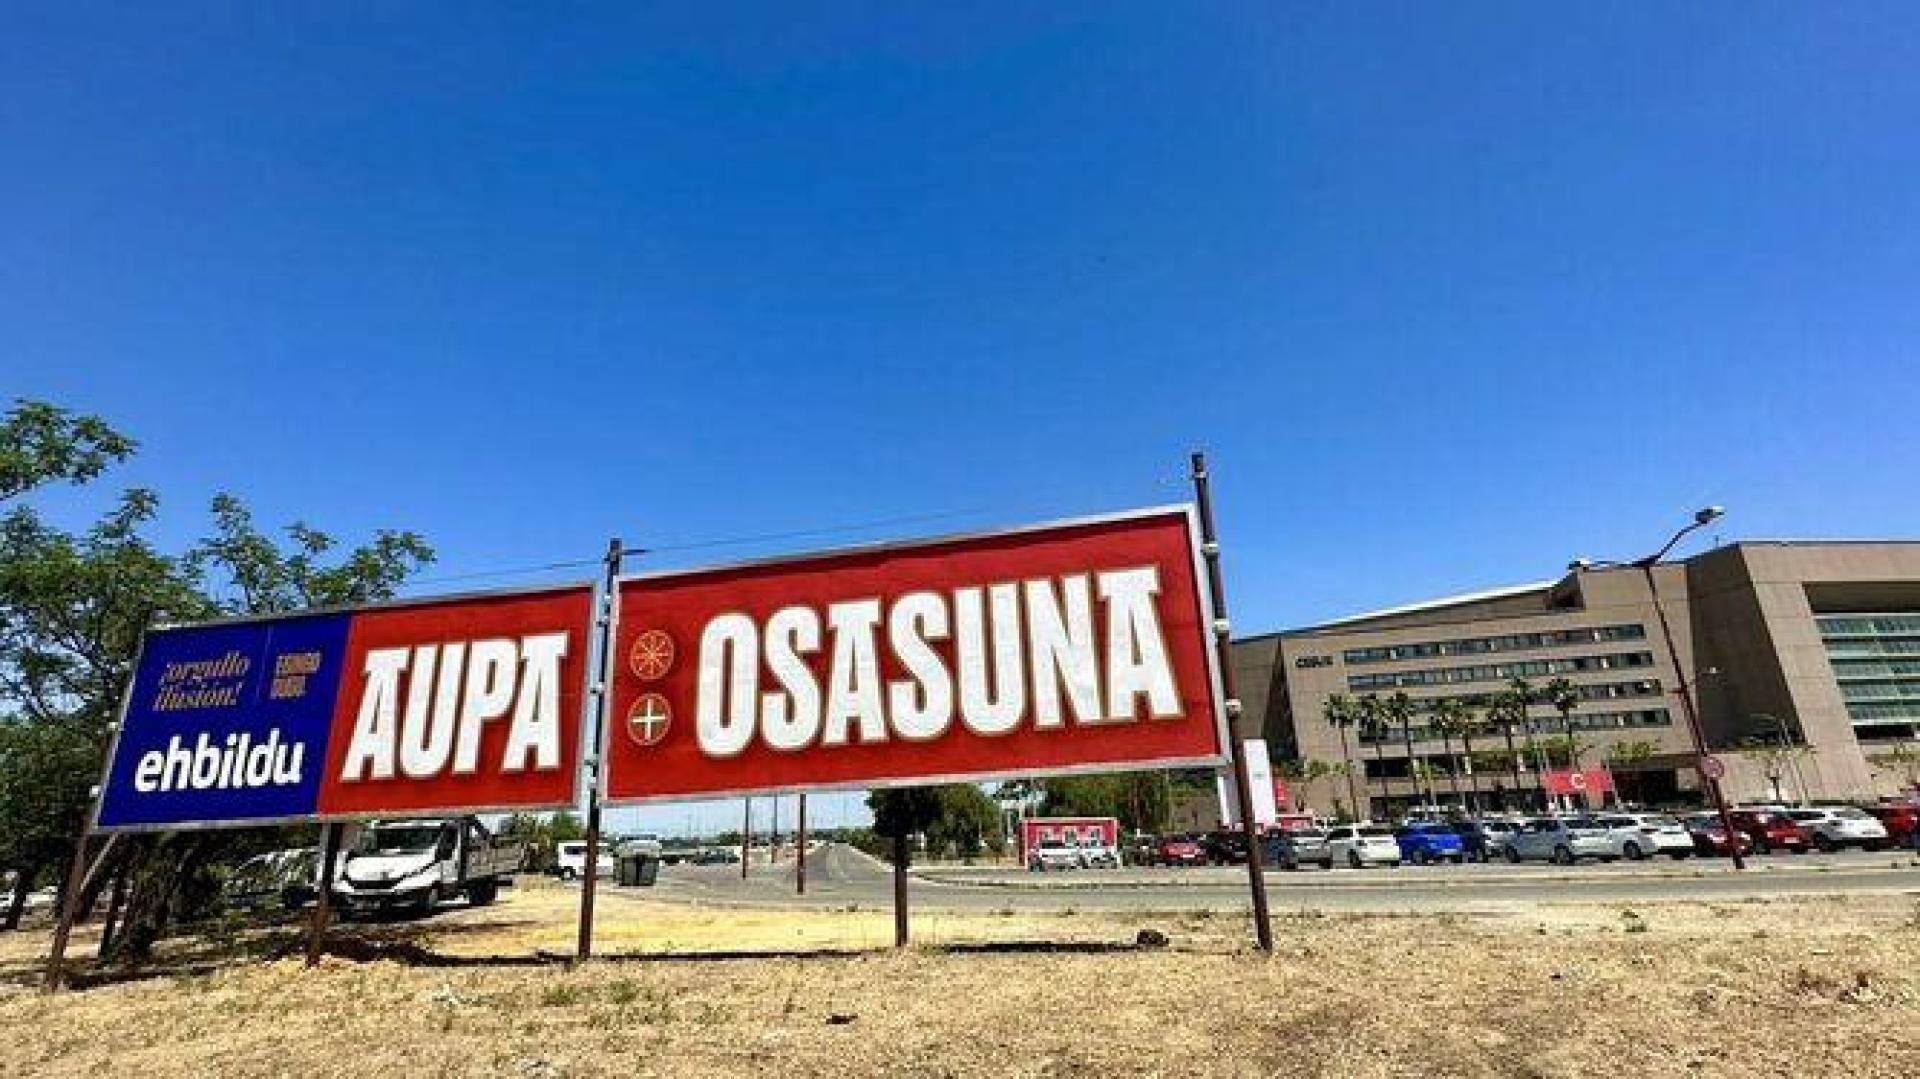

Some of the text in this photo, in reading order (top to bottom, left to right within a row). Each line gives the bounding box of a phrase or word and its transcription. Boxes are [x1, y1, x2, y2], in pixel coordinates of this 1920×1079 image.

[342, 632, 568, 781] AUPA
[696, 565, 1184, 757] OSASUNA
[135, 728, 304, 791] ehbildu
